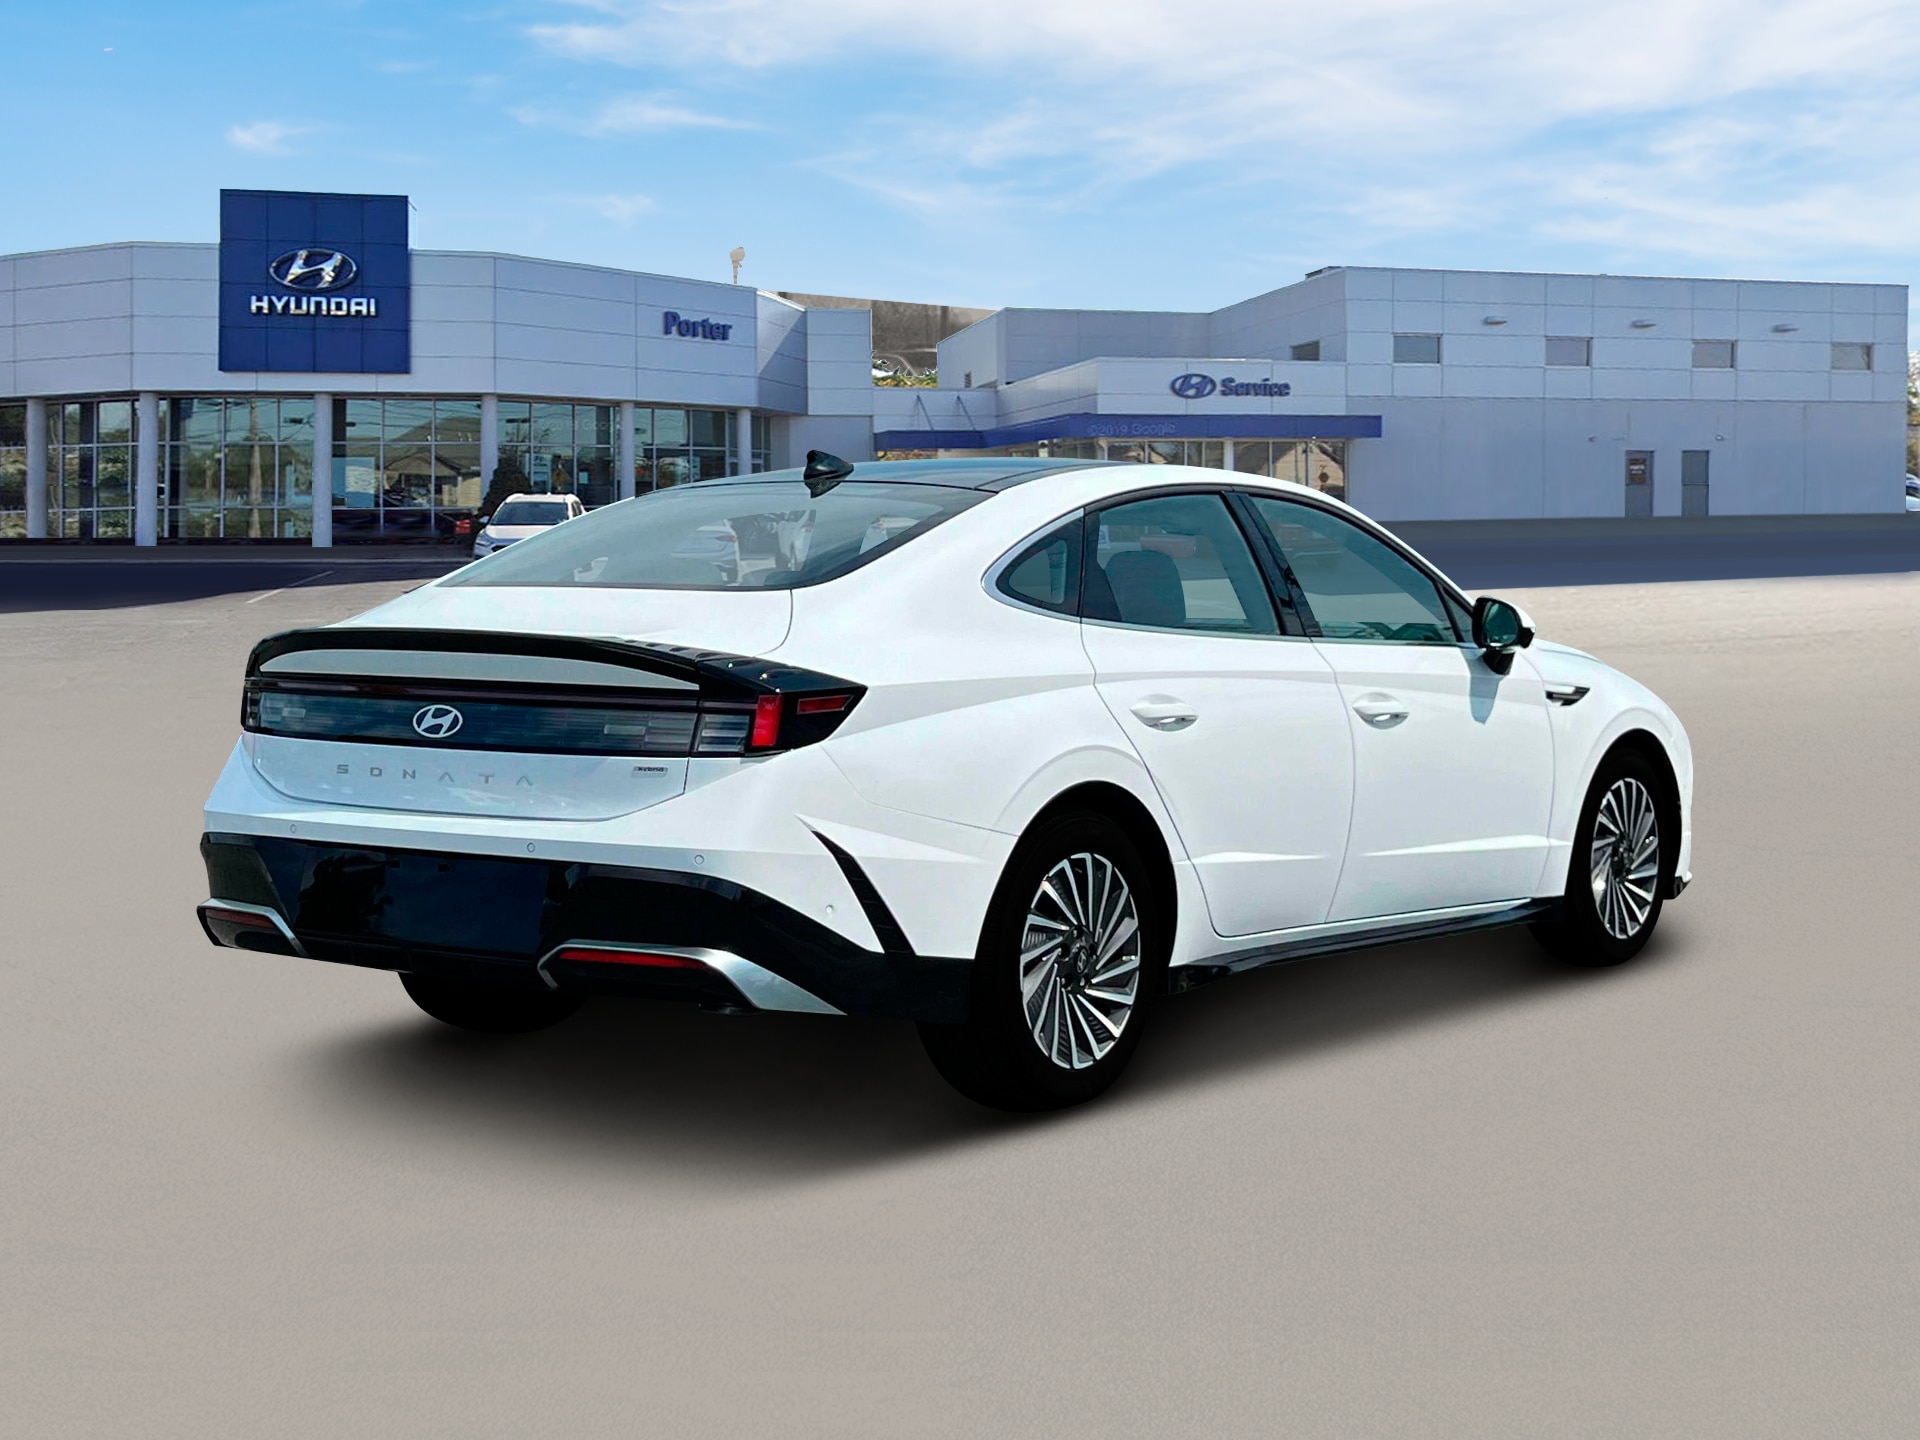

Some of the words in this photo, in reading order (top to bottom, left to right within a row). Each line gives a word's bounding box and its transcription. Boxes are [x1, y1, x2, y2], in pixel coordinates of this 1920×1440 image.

[250, 295, 377, 317] HYUNDAI
[663, 310, 733, 341] Porter
[1220, 377, 1291, 397] Service
[335, 763, 534, 787] SONATA
